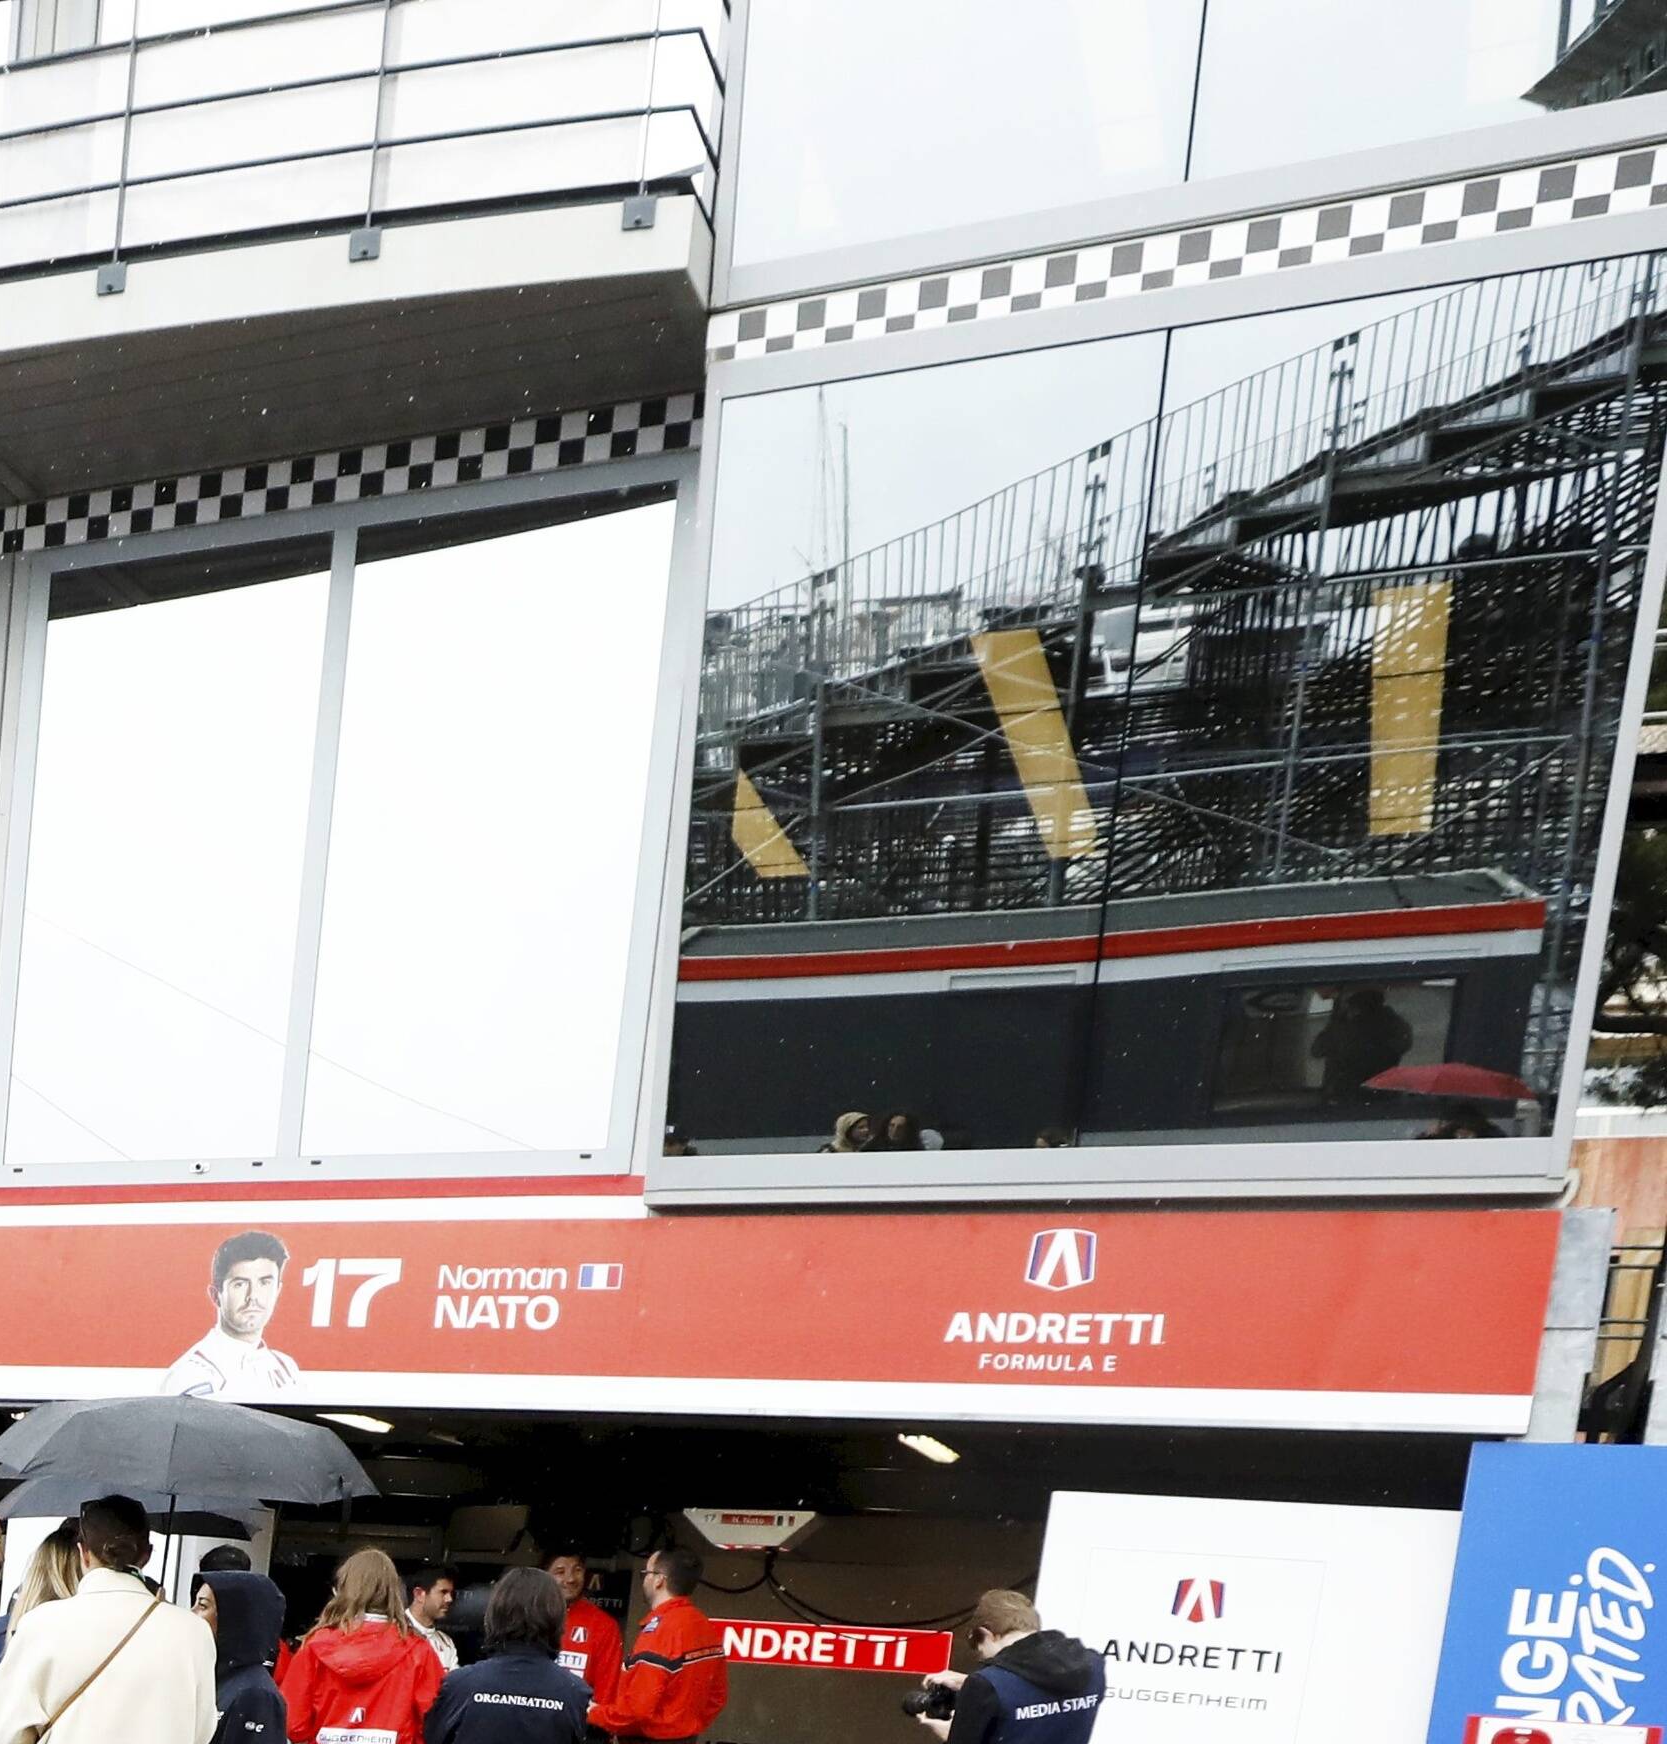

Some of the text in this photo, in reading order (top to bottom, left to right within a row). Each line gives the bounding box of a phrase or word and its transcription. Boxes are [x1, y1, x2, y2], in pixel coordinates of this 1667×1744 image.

[437, 1264, 567, 1290] Norman
[301, 1257, 403, 1328] 17
[433, 1295, 560, 1330] NATO
[943, 1312, 1167, 1345] ANDRETTI
[978, 1353, 1118, 1372] FORMULA E
[723, 1626, 909, 1668] NDRETTI
[1102, 1639, 1283, 1674] ANDRETTI
[473, 1692, 565, 1711] ORGANISATION
[1016, 1693, 1099, 1721] MEDIA STAFF
[1105, 1686, 1269, 1712] GUGGENHEIM
